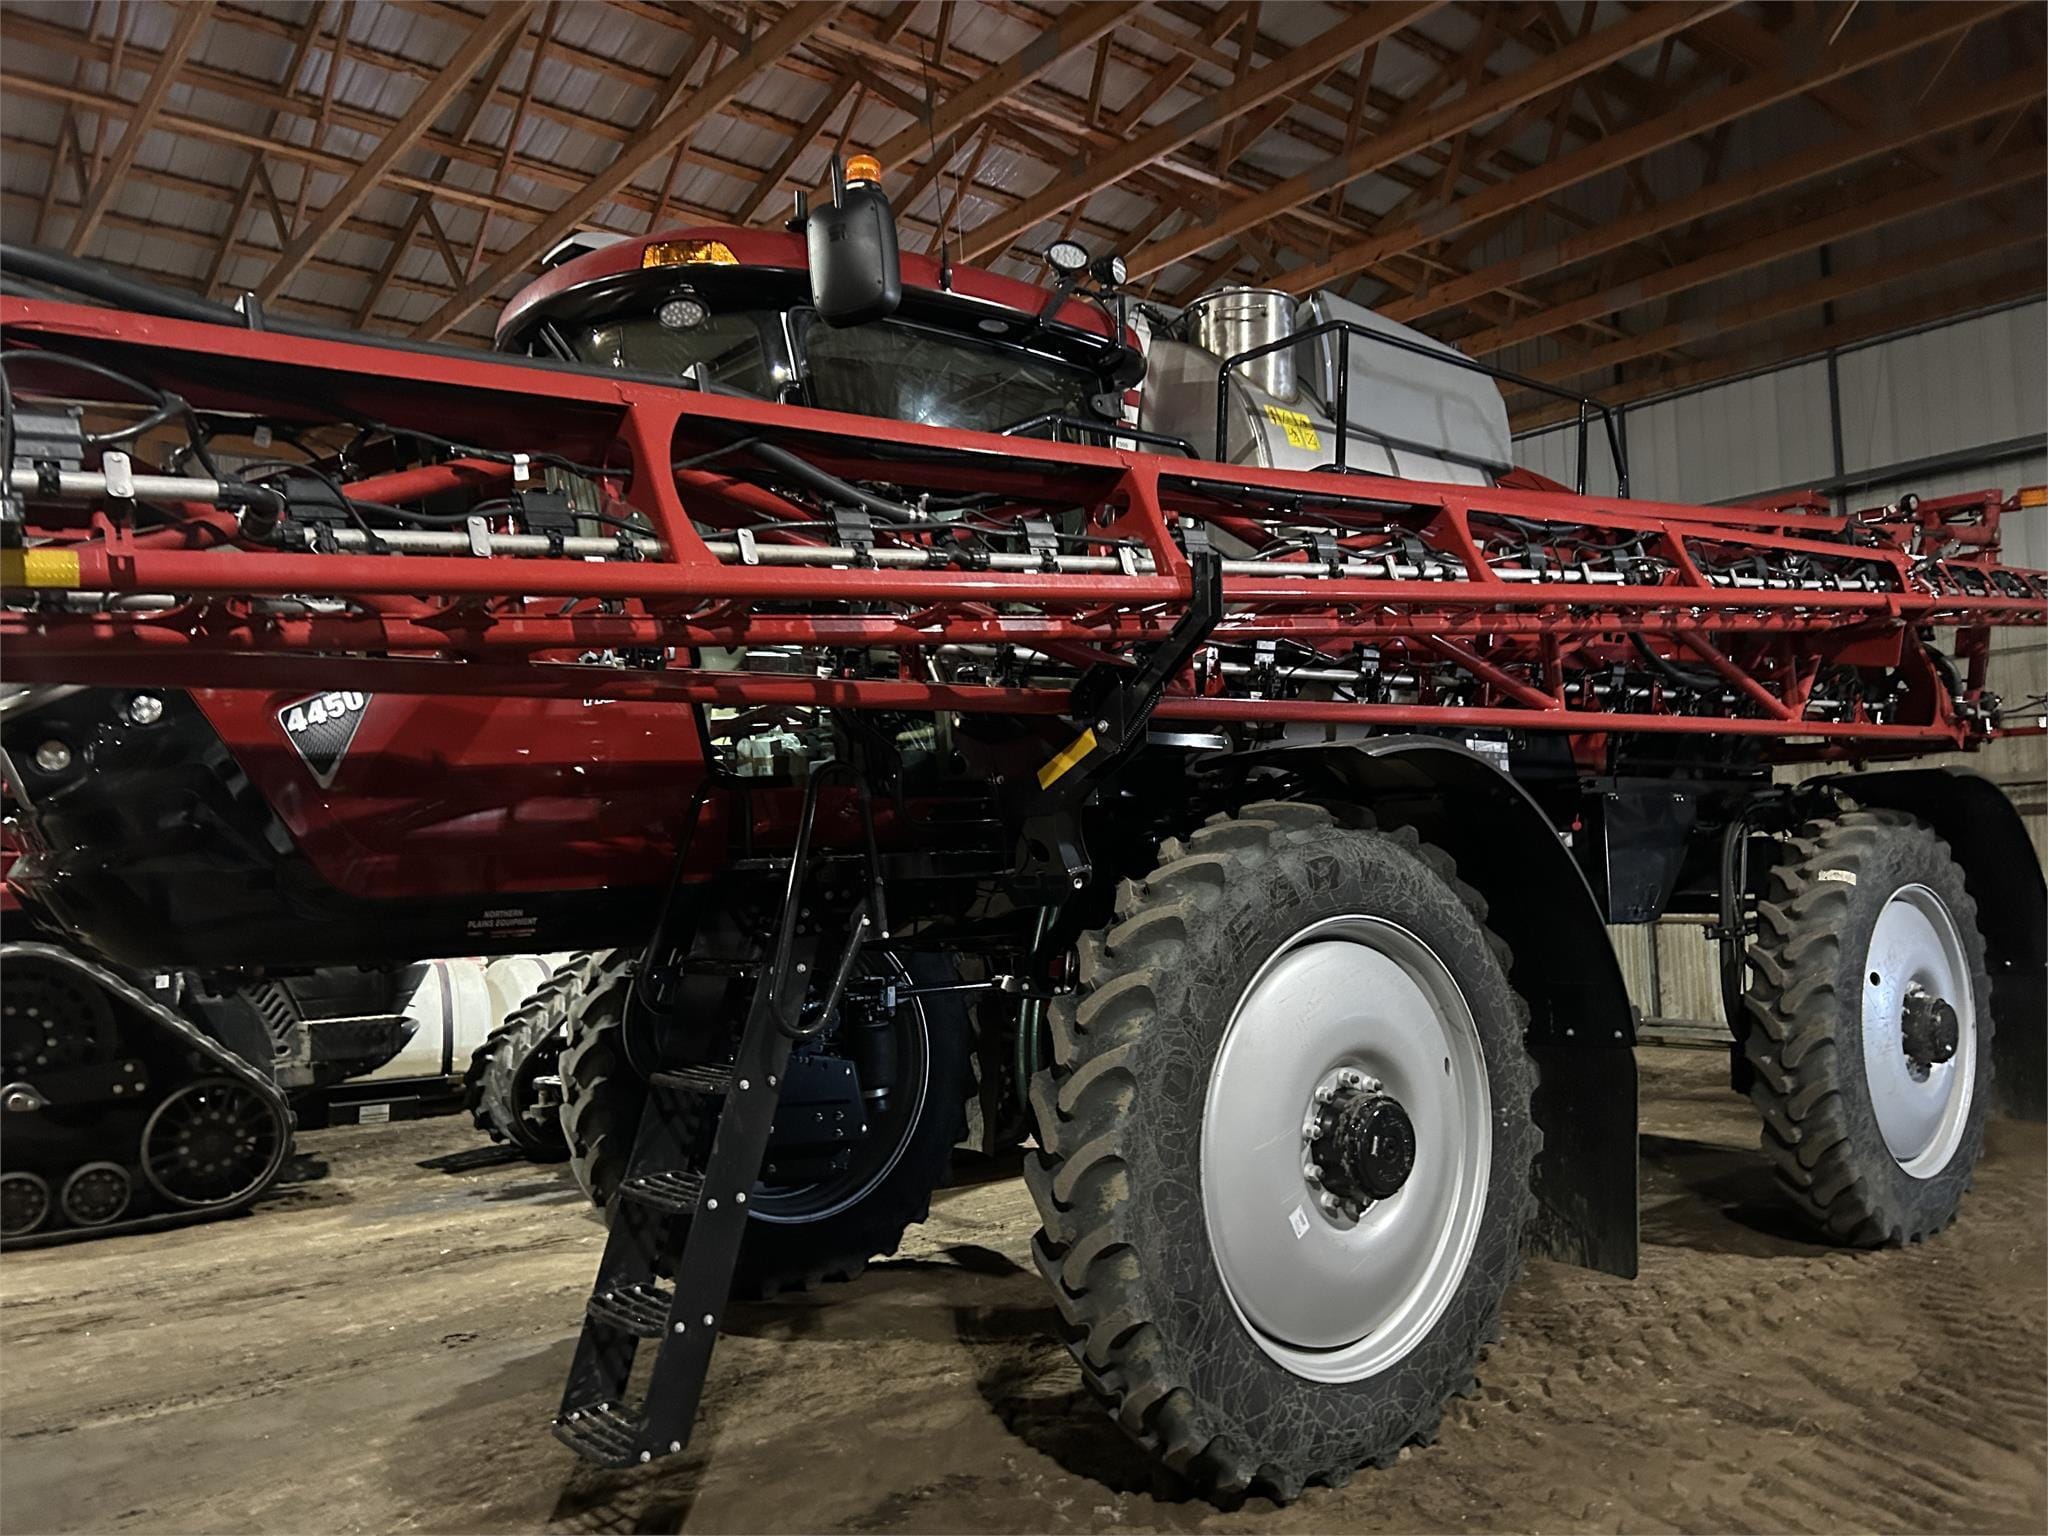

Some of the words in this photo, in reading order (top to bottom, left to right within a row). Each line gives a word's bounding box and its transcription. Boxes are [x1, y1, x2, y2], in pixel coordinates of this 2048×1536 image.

[287, 691, 364, 732] 4450
[483, 909, 524, 918] NORTHERN
[467, 920, 494, 928] PLAINS
[495, 917, 538, 926] EQUIPMENT
